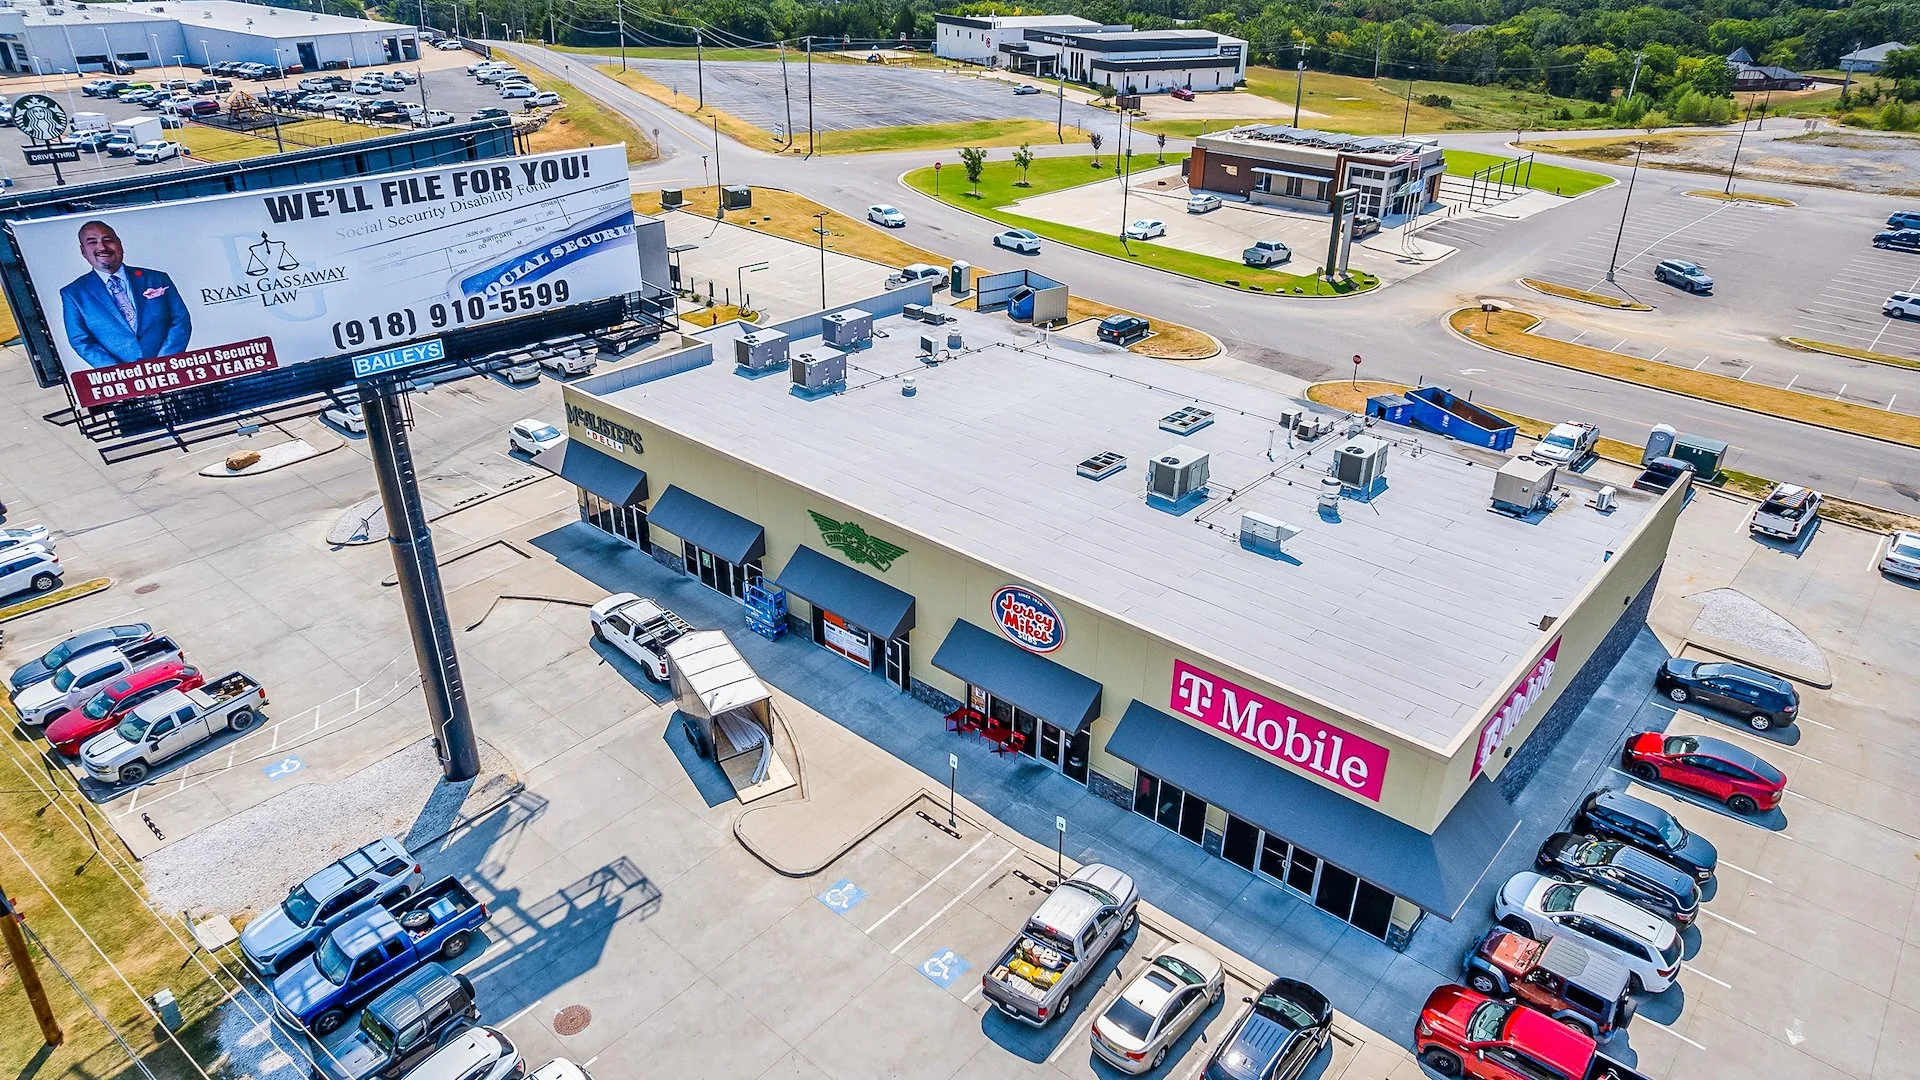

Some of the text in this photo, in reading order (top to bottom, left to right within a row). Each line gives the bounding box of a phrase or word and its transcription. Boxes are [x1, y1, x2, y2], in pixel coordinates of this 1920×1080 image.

[31, 151, 76, 161] DRIVE THRU
[264, 155, 591, 224] WE'LL FILE FOR YOU!
[335, 181, 552, 242] Social Security Disability Form
[200, 283, 251, 303] RYAN
[257, 266, 346, 292] GASSAWAY
[260, 289, 298, 307] LAW
[332, 279, 570, 350] (918) 910-5599
[87, 342, 268, 386] Worked For Social Security
[91, 355, 272, 400] FOR OVER 13 YEARS.
[355, 343, 442, 376] BAILEYS
[592, 432, 617, 449] DELI
[1000, 594, 1054, 632] Jersey
[1217, 687, 1369, 789] Mobile
